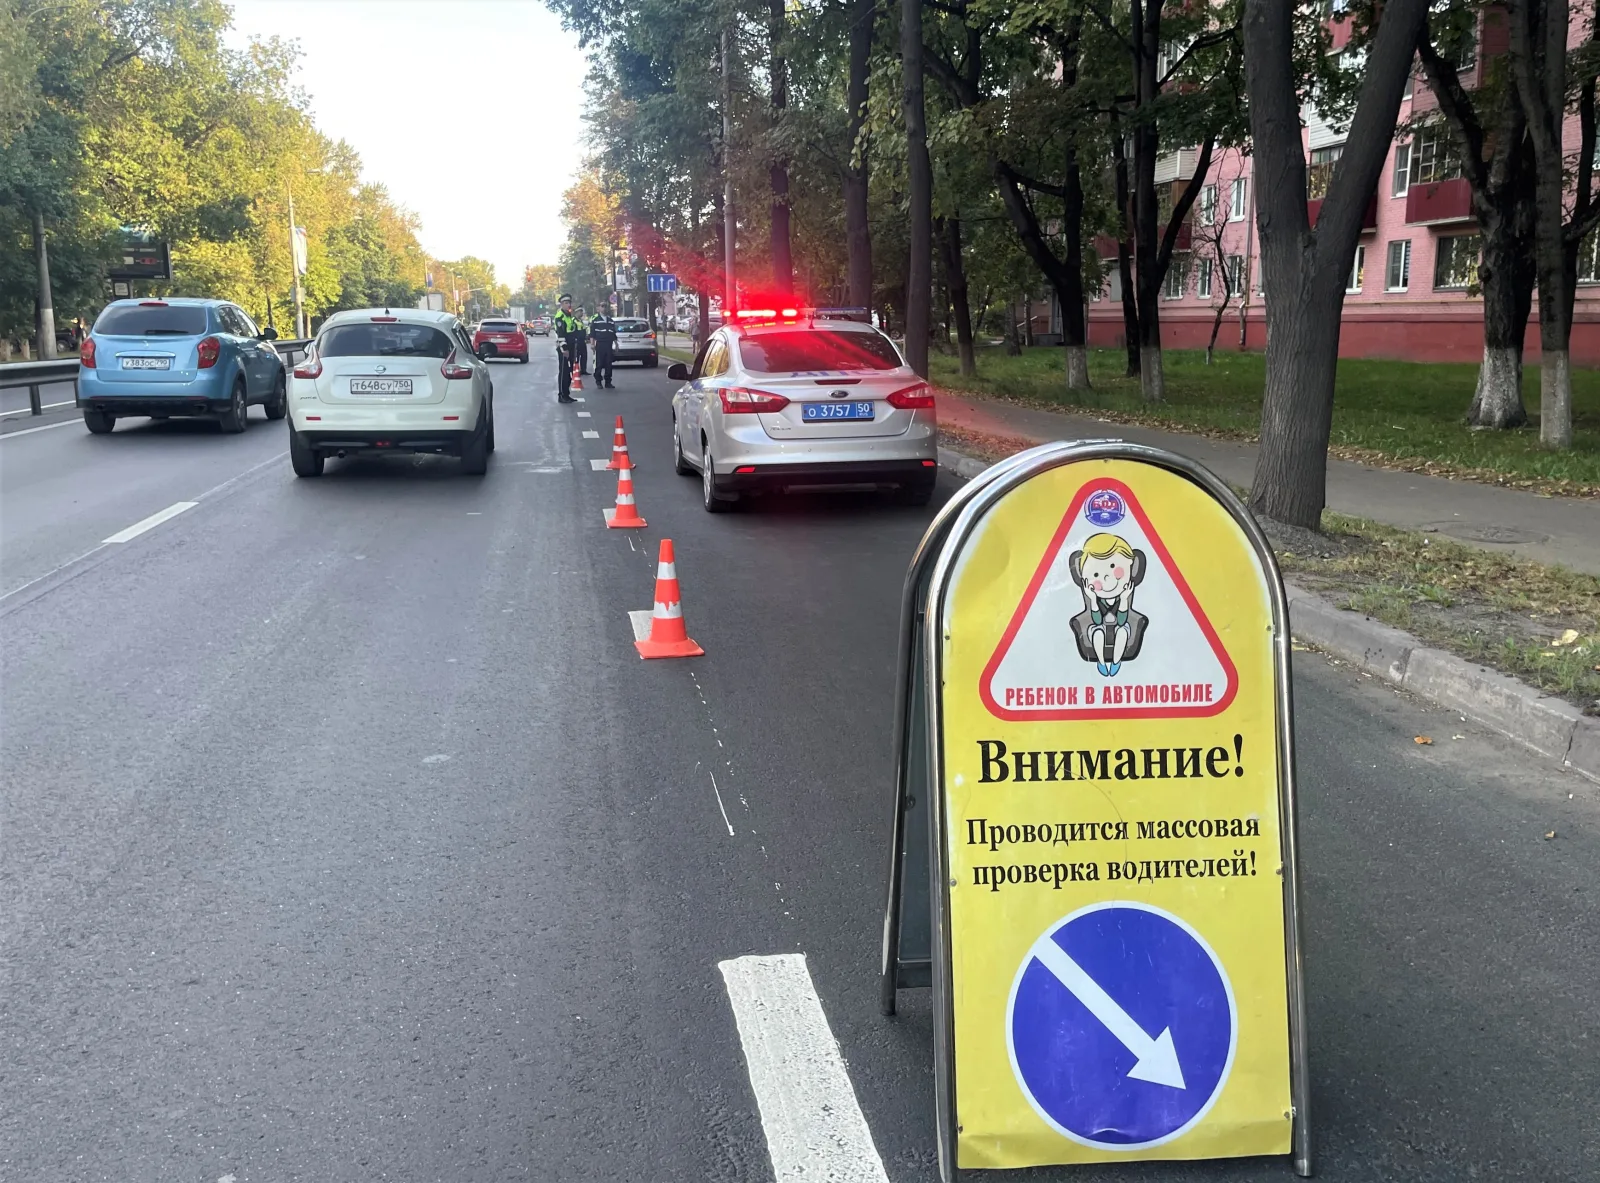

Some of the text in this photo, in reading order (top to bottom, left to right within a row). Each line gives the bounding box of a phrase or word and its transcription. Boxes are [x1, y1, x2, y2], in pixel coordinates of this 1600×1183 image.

[394, 380, 409, 388] 750
[820, 404, 851, 417] 3757
[857, 402, 870, 413] 50
[1005, 683, 1213, 707] РЕБЕНОК В АВТОМОБИЛЕ
[976, 733, 1245, 783] Внимание!
[966, 816, 1261, 852] Проводится массовая
[972, 849, 1257, 892] проверка водителей!
